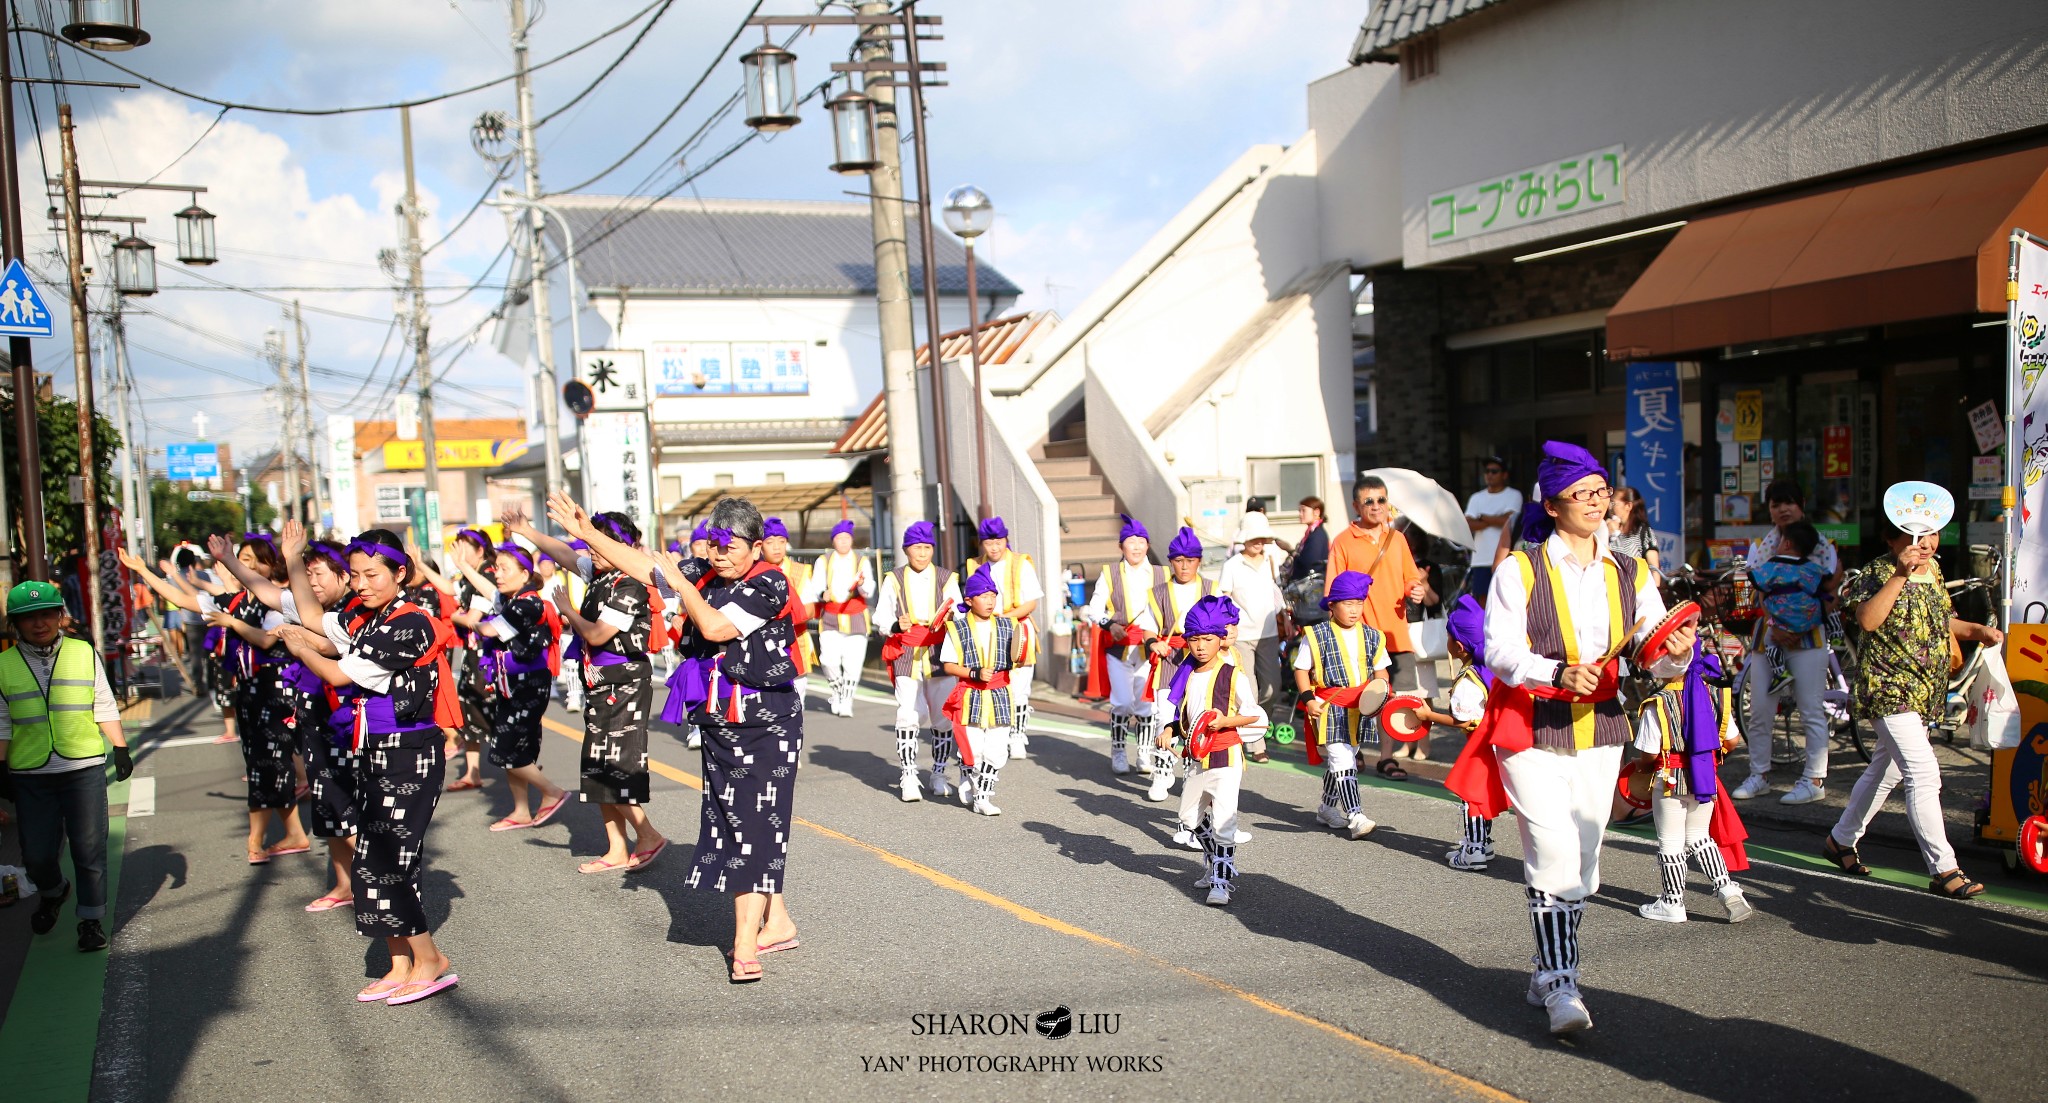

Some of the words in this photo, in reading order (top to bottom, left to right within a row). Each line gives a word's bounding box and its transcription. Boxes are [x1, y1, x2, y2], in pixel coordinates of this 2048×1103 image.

[1431, 153, 1619, 240] コープみらい
[406, 445, 481, 464] KGNUS
